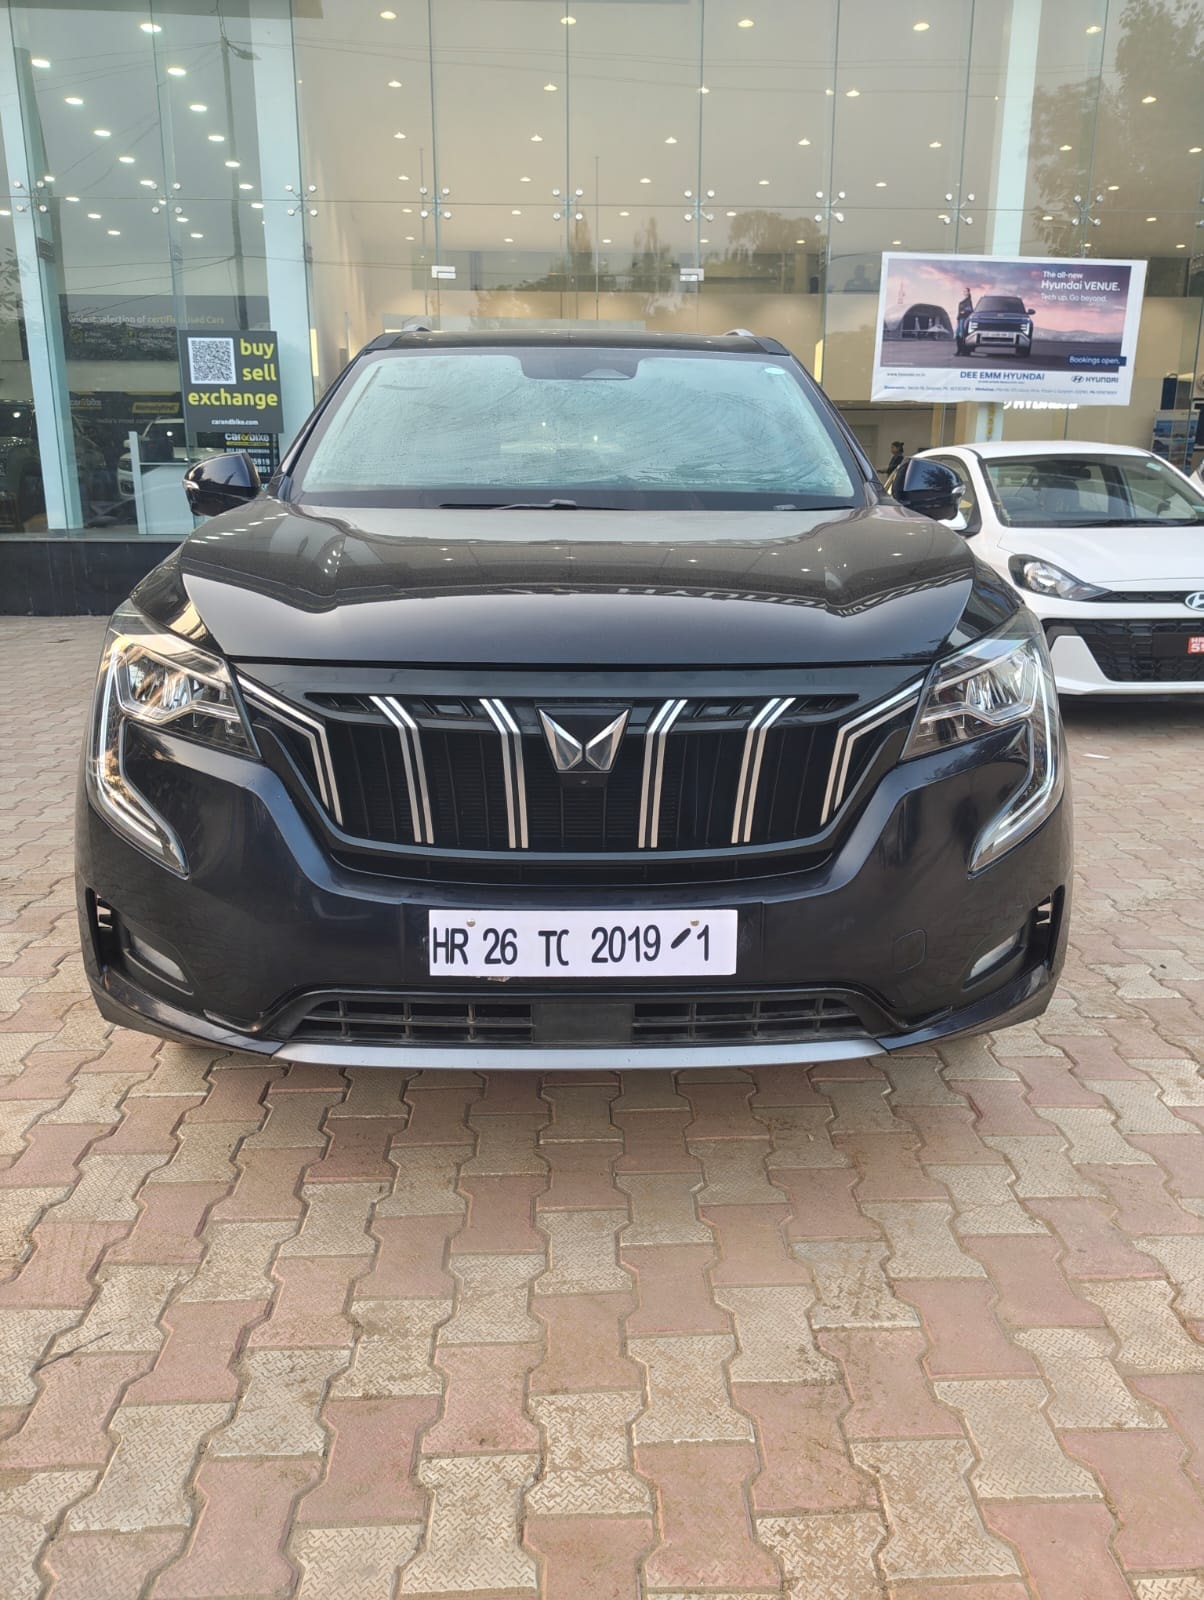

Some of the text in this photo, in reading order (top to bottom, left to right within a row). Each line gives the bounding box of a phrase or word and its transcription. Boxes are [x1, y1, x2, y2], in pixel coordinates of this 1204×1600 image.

[1057, 271, 1083, 279] all-new
[1041, 280, 1121, 292] Hyundai VENUE.
[1041, 293, 1057, 301] Tech
[1069, 294, 1080, 302] Go
[240, 338, 274, 359] buy
[1069, 356, 1100, 366] Bookings
[242, 363, 277, 381] sell
[960, 371, 1045, 381] DEE EMM HYUNDAI
[1085, 376, 1119, 384] HYUNDAI
[188, 387, 278, 410] exchange
[432, 927, 469, 965] HR
[483, 927, 518, 966] 26
[538, 929, 570, 967] TC
